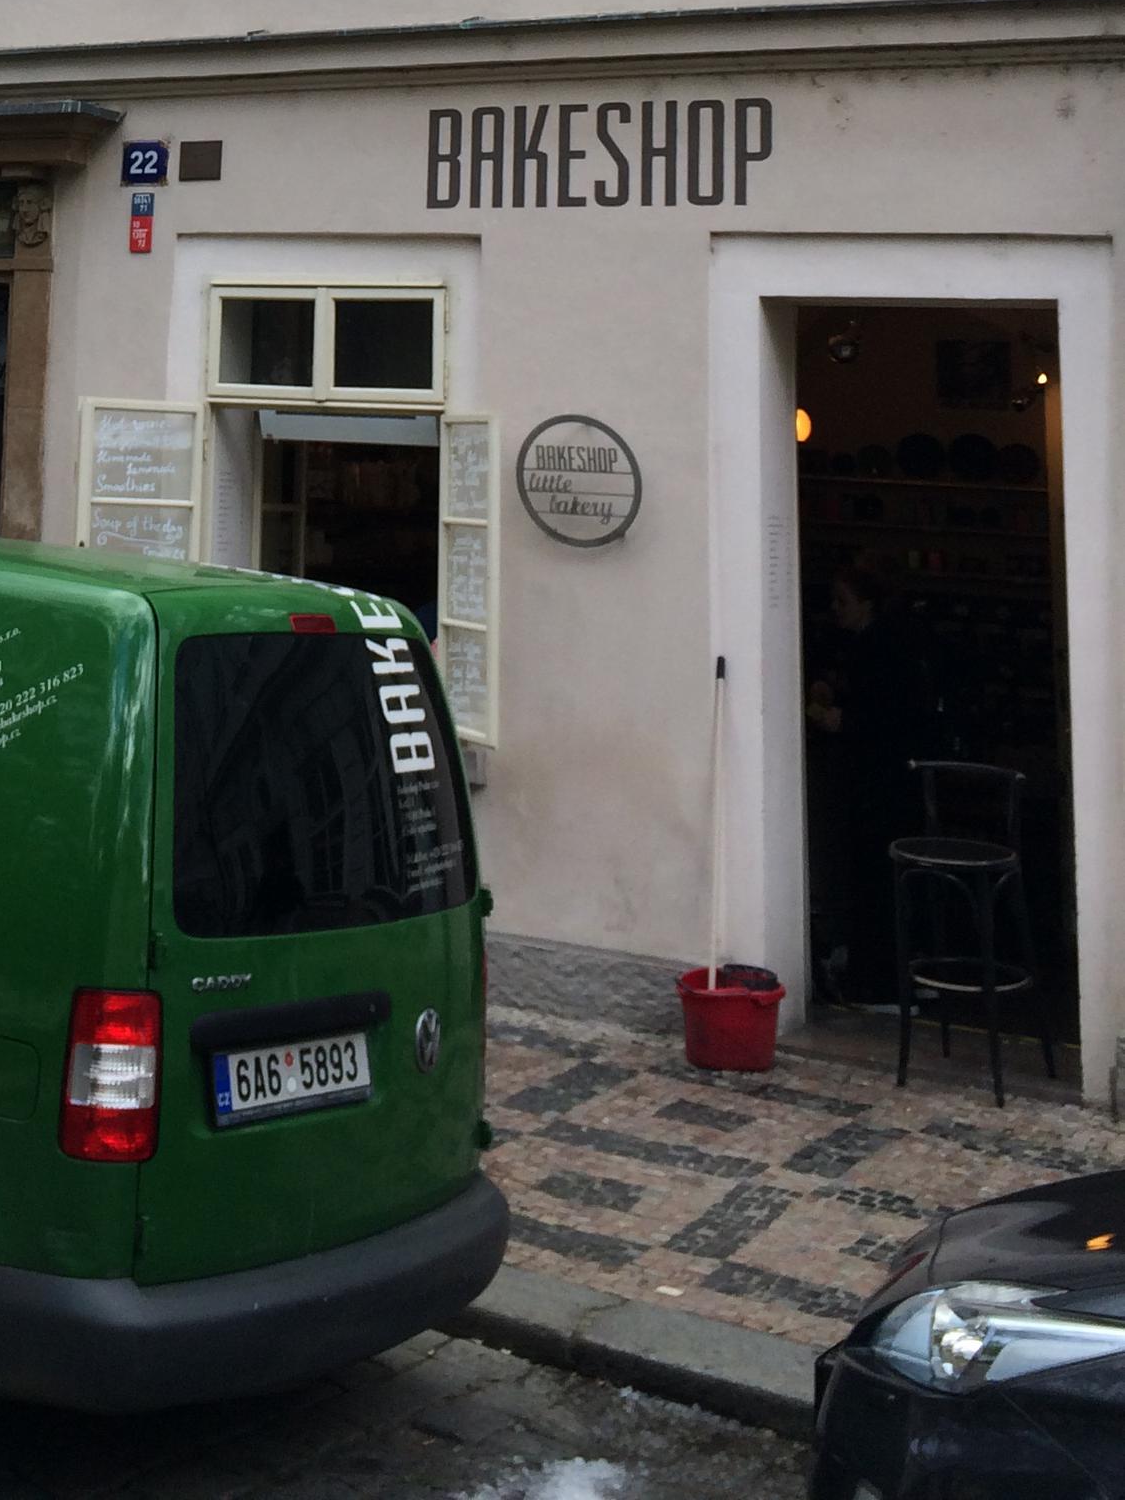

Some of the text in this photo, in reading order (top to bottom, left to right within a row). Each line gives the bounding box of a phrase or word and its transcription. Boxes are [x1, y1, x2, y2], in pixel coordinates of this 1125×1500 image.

[129, 150, 159, 175] 22
[426, 97, 772, 209] BAKESHOP
[536, 444, 618, 473] BAKESHOP
[528, 473, 573, 493] little
[549, 495, 613, 525] bakery
[15, 687, 36, 706] 222
[39, 675, 61, 694] 316
[62, 663, 84, 682] 823
[191, 973, 252, 991] CADDY
[236, 1040, 358, 1102] 6A6 5893
[218, 1091, 231, 1107] CZ
